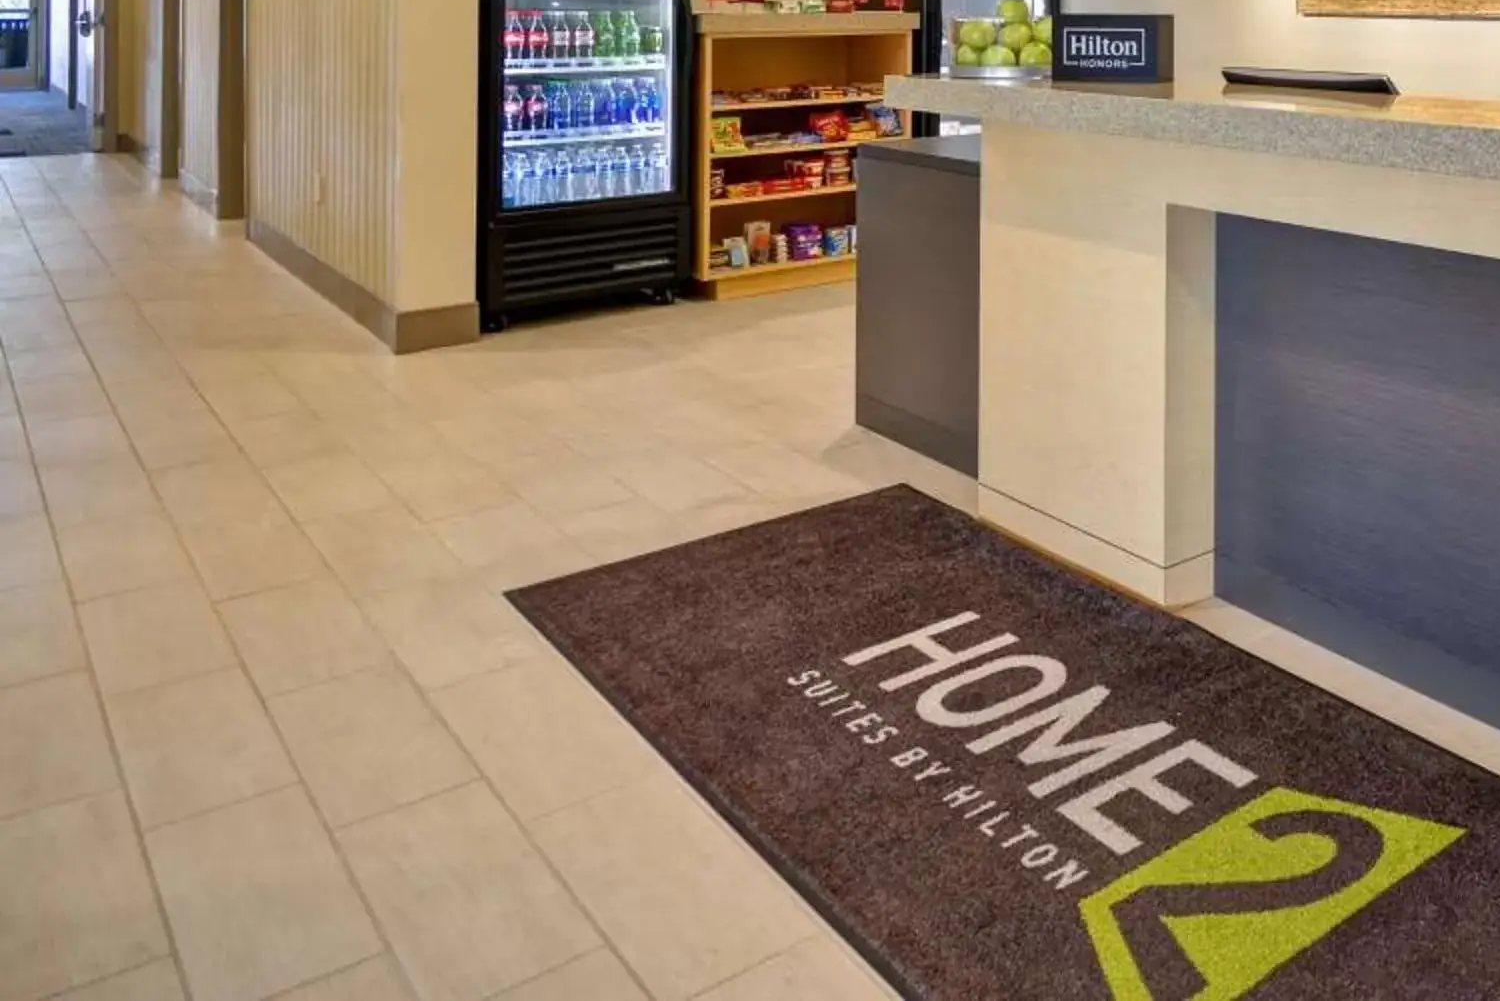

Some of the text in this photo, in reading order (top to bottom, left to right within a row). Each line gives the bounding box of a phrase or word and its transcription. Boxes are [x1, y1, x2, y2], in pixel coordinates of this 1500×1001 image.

[1068, 34, 1138, 57] Hilton
[1079, 59, 1129, 69] HONORS
[787, 670, 1089, 890] SUITES BY HILTON
